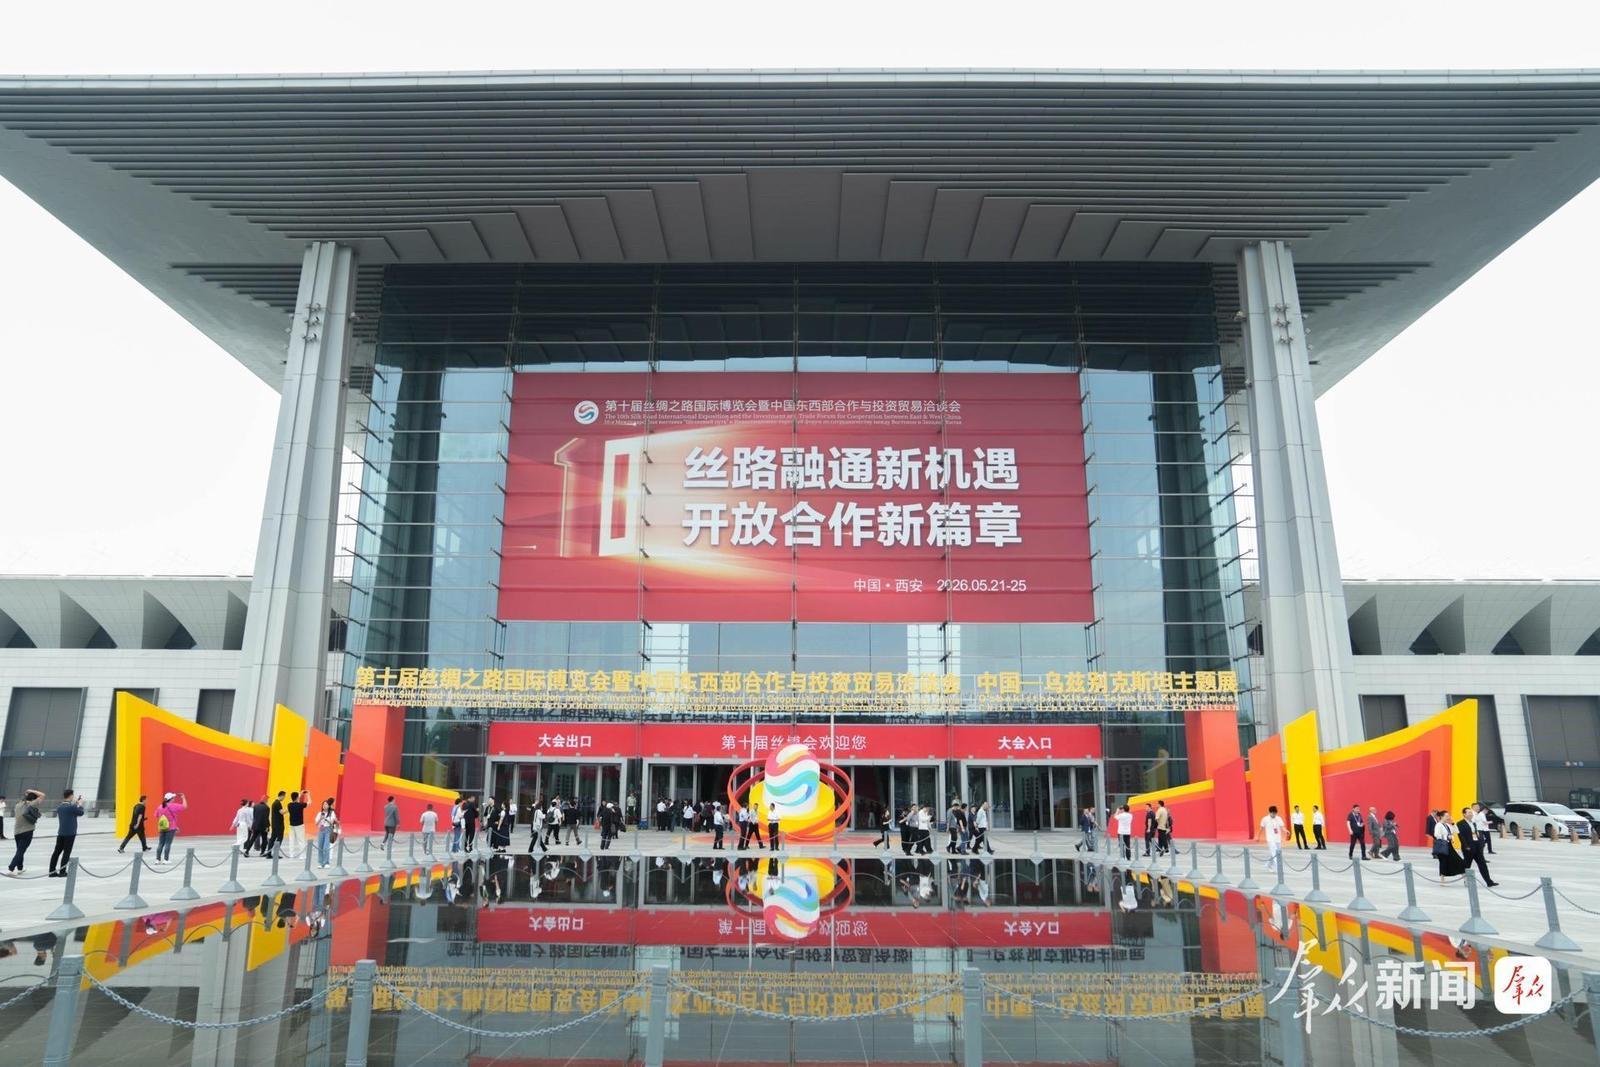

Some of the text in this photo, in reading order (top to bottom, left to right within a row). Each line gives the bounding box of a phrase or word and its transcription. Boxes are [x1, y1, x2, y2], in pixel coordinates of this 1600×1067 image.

[682, 446, 1020, 490] 丝路融通新机遇
[681, 501, 1022, 547] 开放合作新篇章
[936, 579, 1027, 592] 2026.05.21-25
[538, 733, 592, 748] 大会出口
[998, 736, 1052, 750] 大会入口
